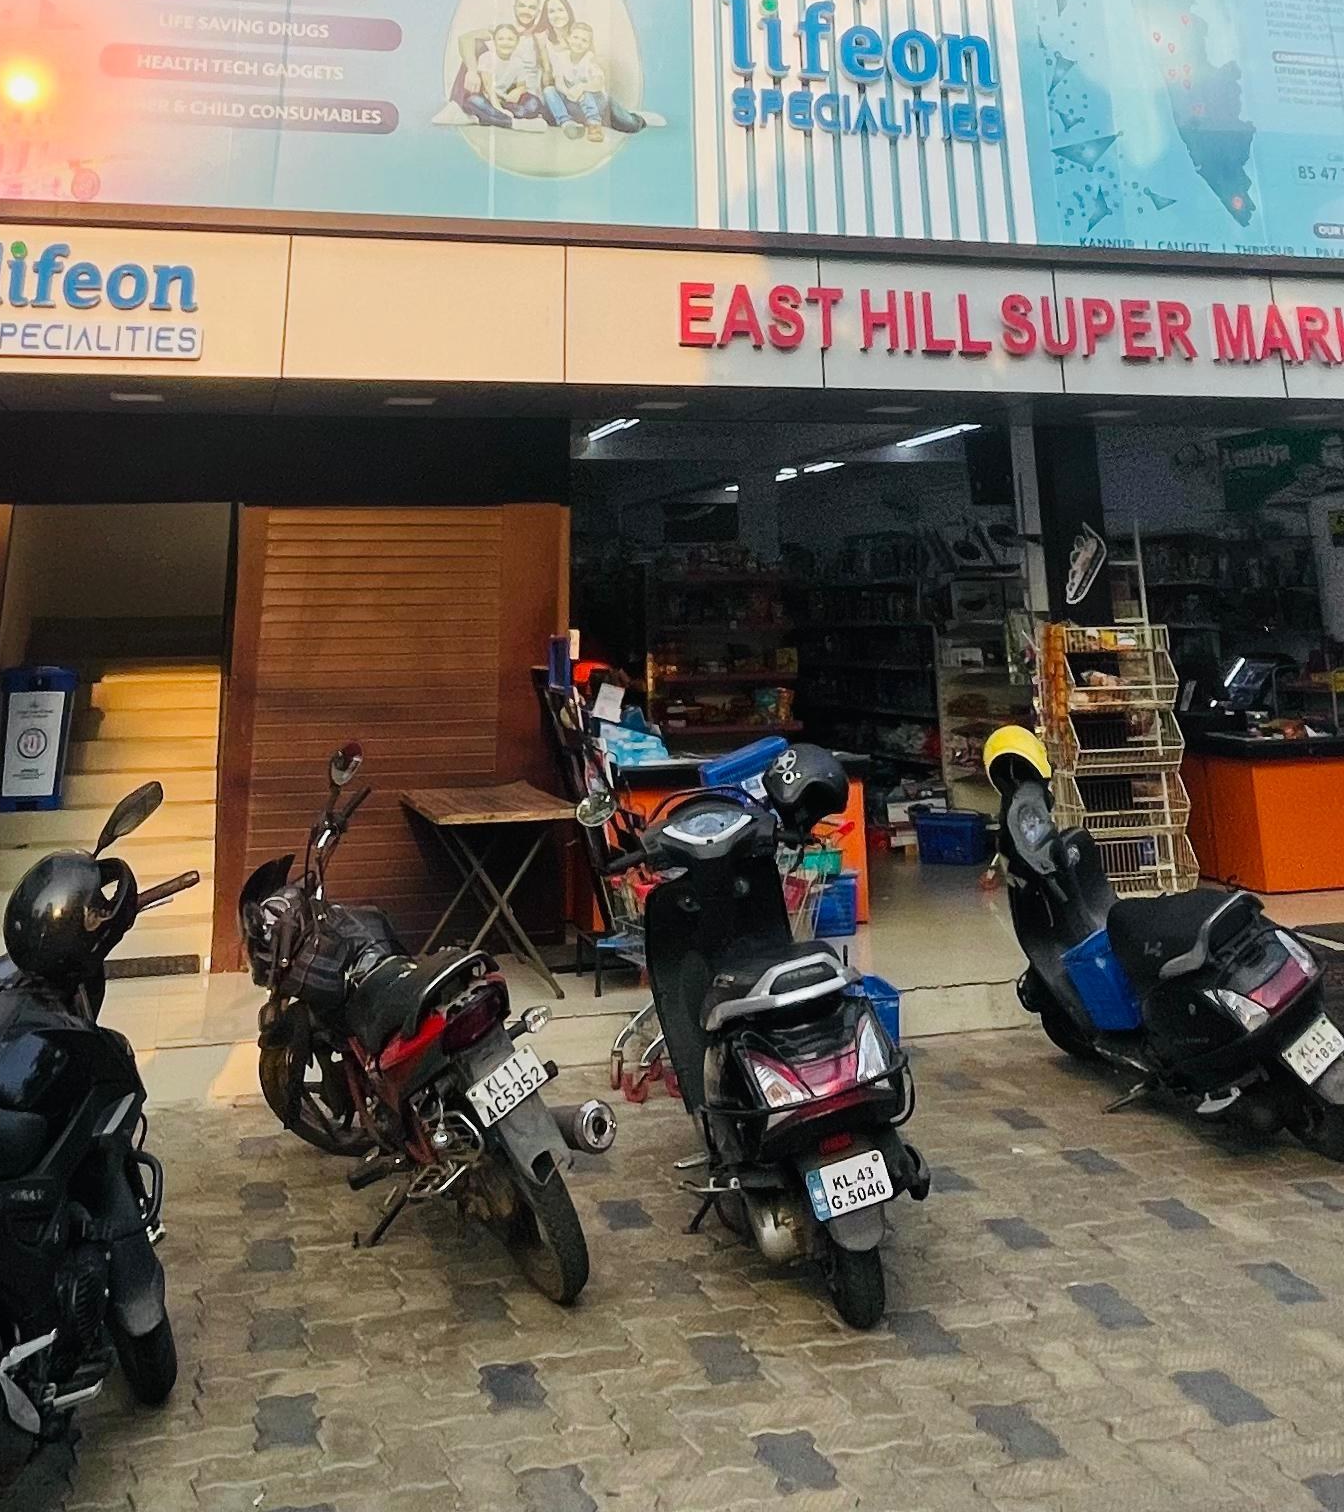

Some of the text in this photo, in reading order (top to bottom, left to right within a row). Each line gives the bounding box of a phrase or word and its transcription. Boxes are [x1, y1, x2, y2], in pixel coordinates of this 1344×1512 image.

[158, 13, 330, 39] LIFE SAVING DRUGS
[136, 54, 345, 81] HEALTH TECH GADGETS
[173, 99, 190, 114] &
[190, 101, 246, 118] CHILD
[248, 103, 383, 125] CONSUMABLES
[731, 87, 1005, 144] SPECIALITIES
[1297, 165, 1316, 180] 85
[1320, 167, 1337, 182] 47
[1318, 224, 1341, 236] OUR
[1079, 237, 1136, 249] KANNUR
[1157, 240, 1211, 252] CALICUT
[1234, 244, 1295, 256] THRISSUR
[678, 281, 844, 351] EAST
[859, 288, 993, 356] HILL
[1000, 293, 1199, 361] SUPER
[1297, 1043, 1315, 1059] KL
[483, 1057, 524, 1099] KL 11
[486, 1066, 544, 1123] AC5352
